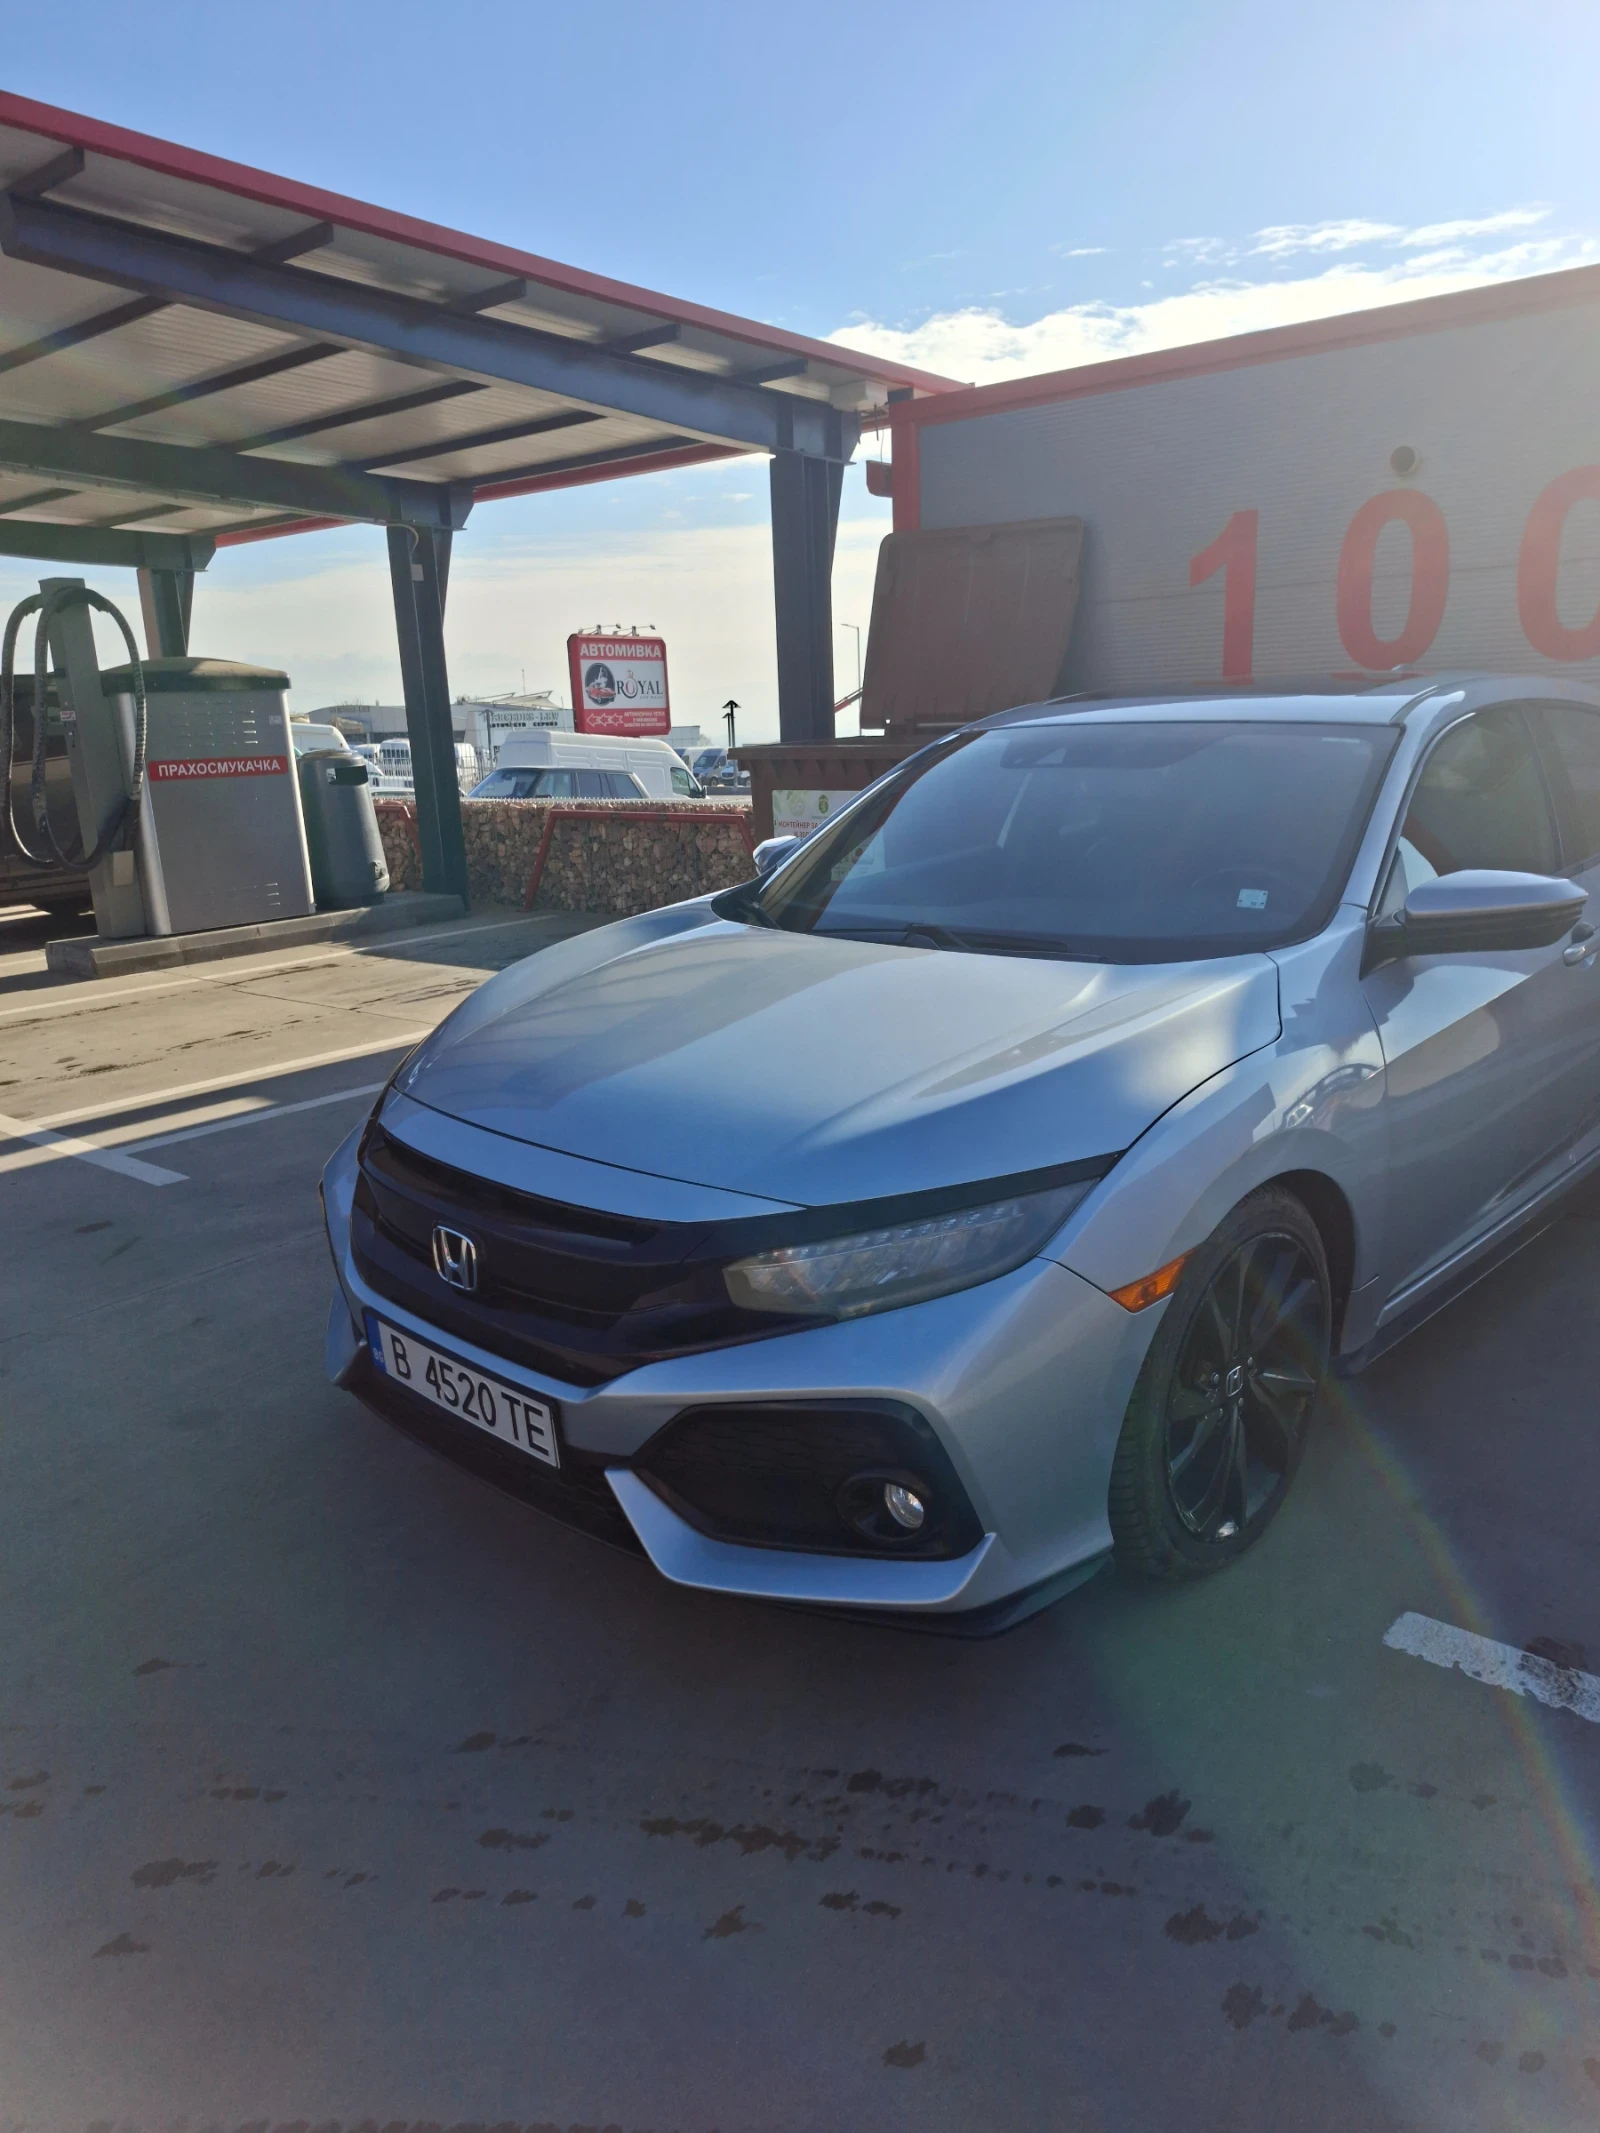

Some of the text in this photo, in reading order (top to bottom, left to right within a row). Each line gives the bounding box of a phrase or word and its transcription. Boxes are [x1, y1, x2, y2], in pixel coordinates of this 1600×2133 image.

[580, 643, 661, 658] АВТОМИВКА
[616, 678, 663, 699] ROYAL
[158, 759, 280, 777] ПРАХОСМУКАЧКА
[779, 820, 810, 828] КОНТЕЙНЕР
[373, 1347, 384, 1363] BG
[391, 1333, 550, 1457] B 4520 TE
